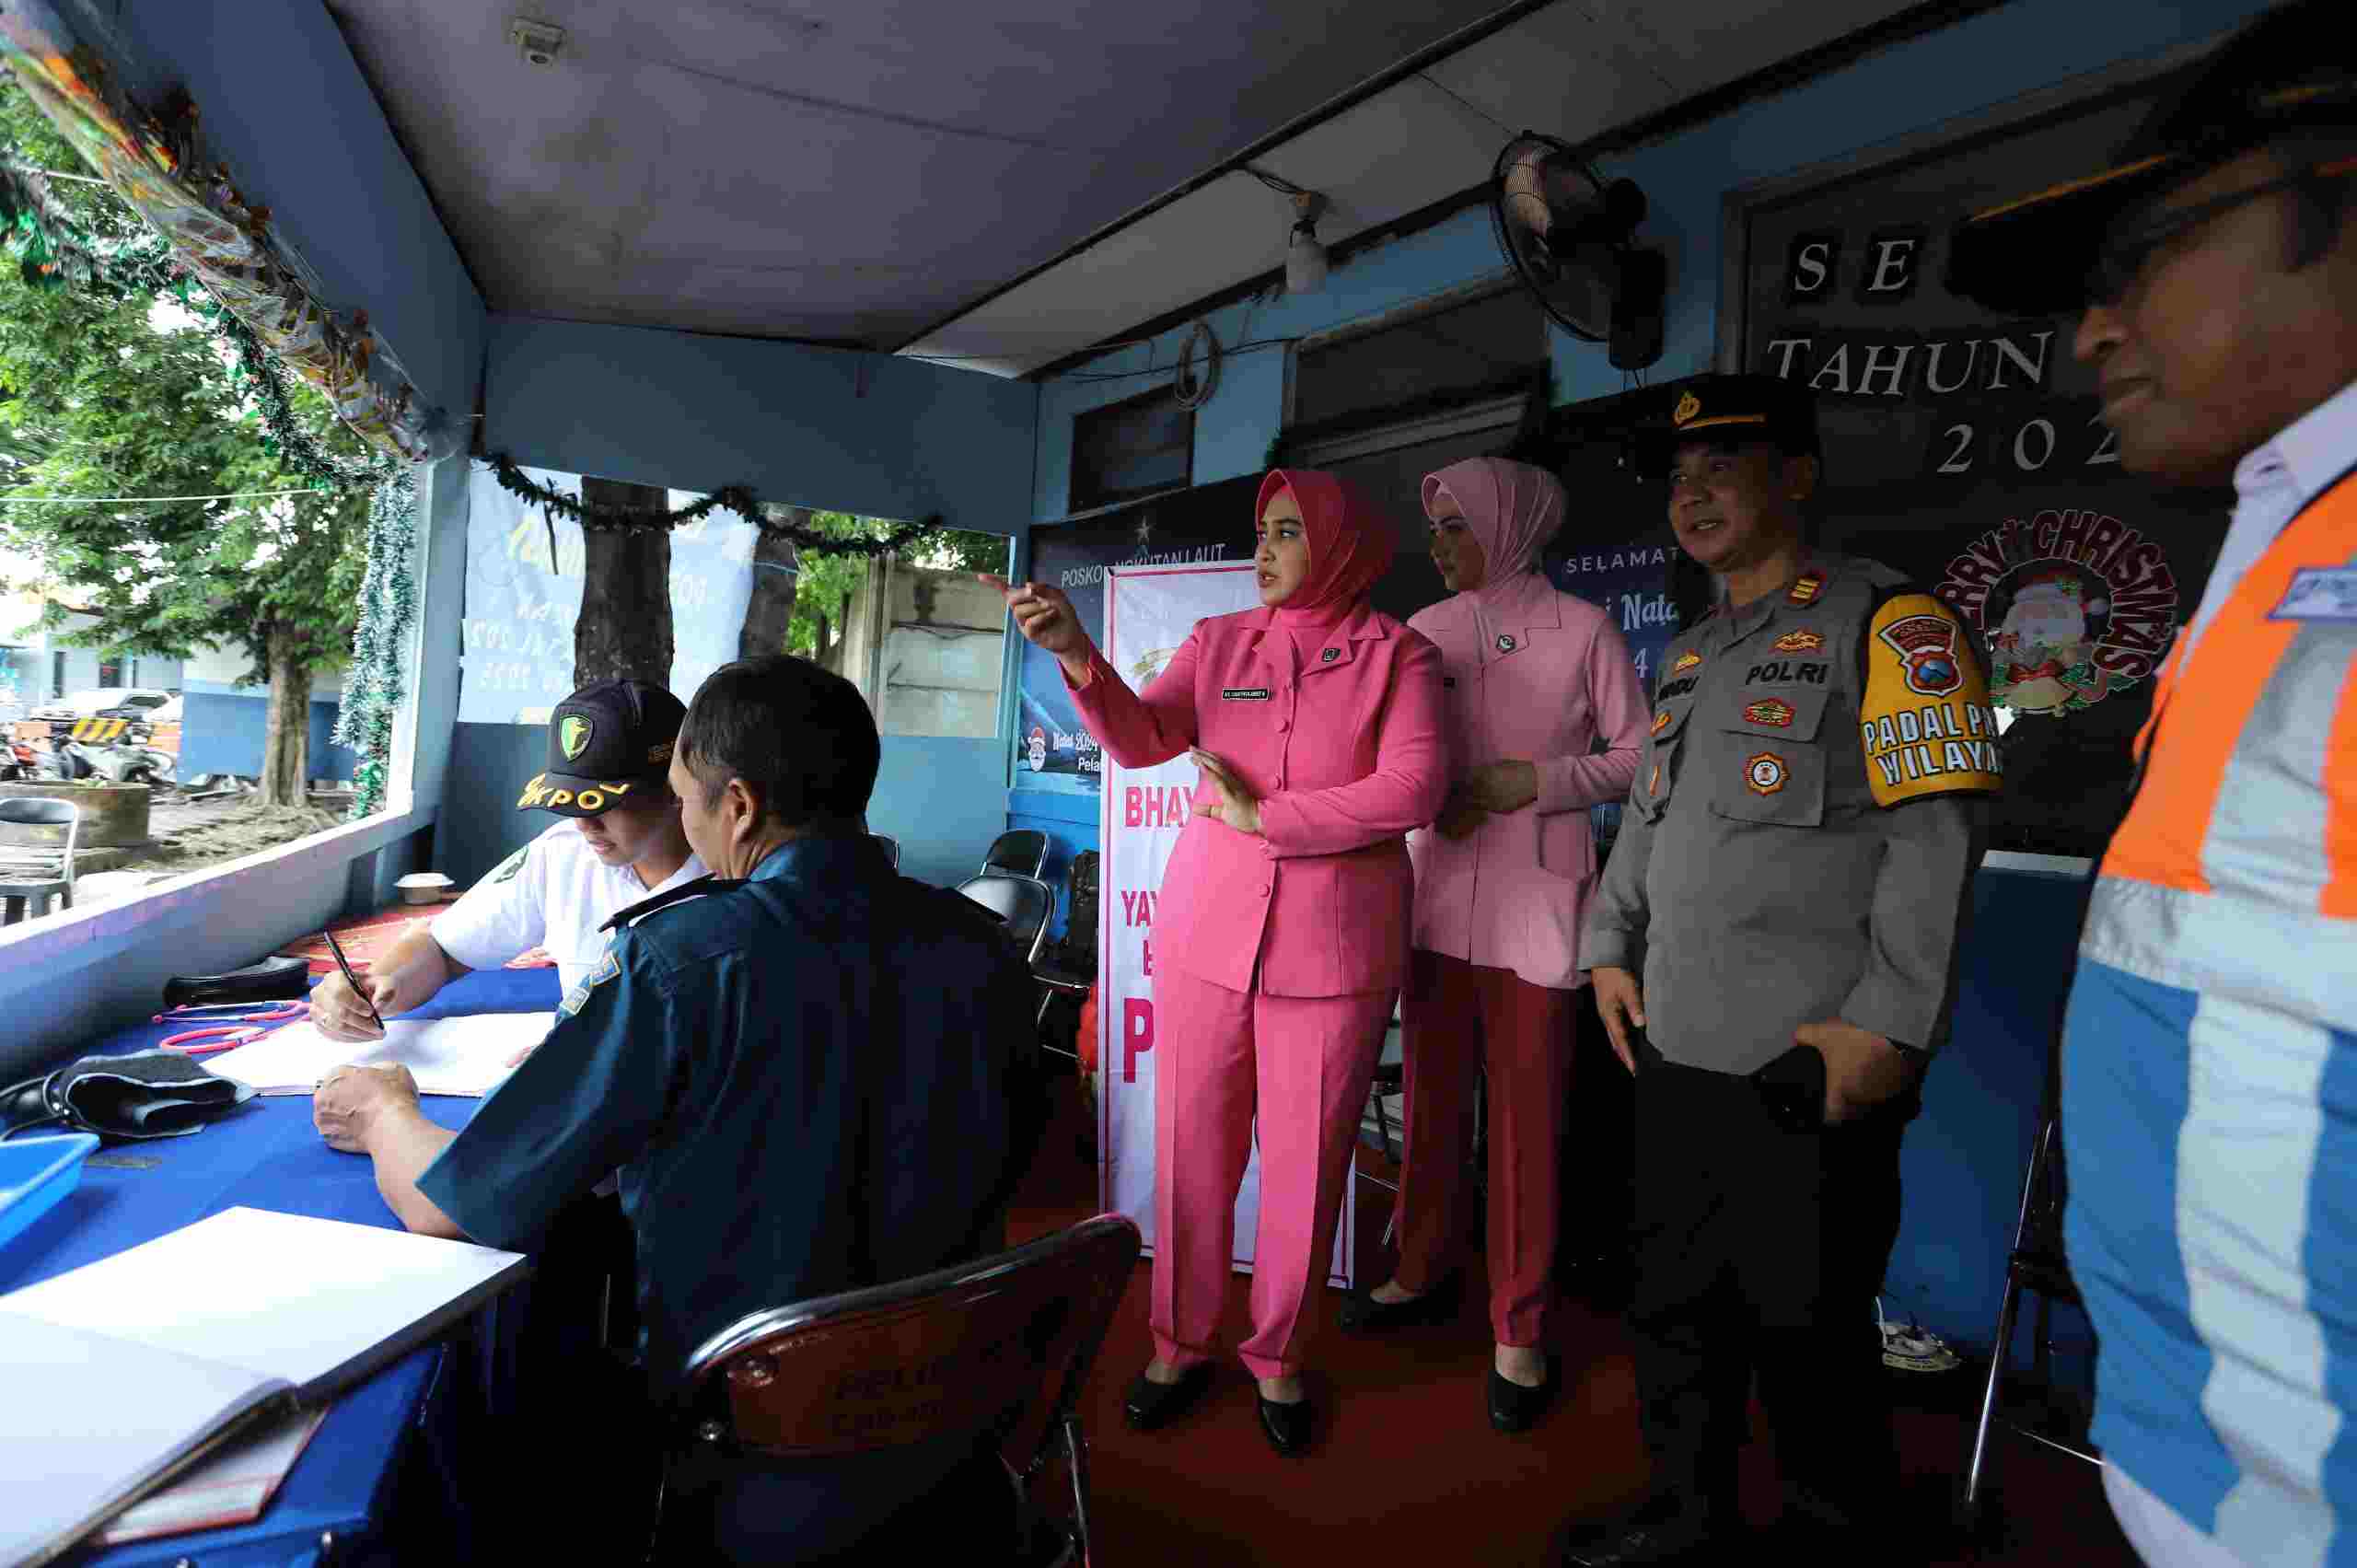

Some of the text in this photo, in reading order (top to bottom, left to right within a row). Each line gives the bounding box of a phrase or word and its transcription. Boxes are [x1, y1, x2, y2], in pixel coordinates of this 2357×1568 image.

[1794, 239, 1916, 292] SE
[1768, 331, 2055, 396] TAHUN
[1936, 412, 2121, 473] 202
[1061, 564, 1105, 587] POSKO
[1566, 546, 1680, 575] SELAMAT
[2032, 508, 2179, 679] CHRISTMAS
[1745, 662, 1829, 686] POLRI
[1863, 703, 1963, 755] PADAL
[1077, 756, 1100, 772] Pela
[1872, 739, 2003, 787] WILAYA
[1125, 786, 1194, 827] BHAY
